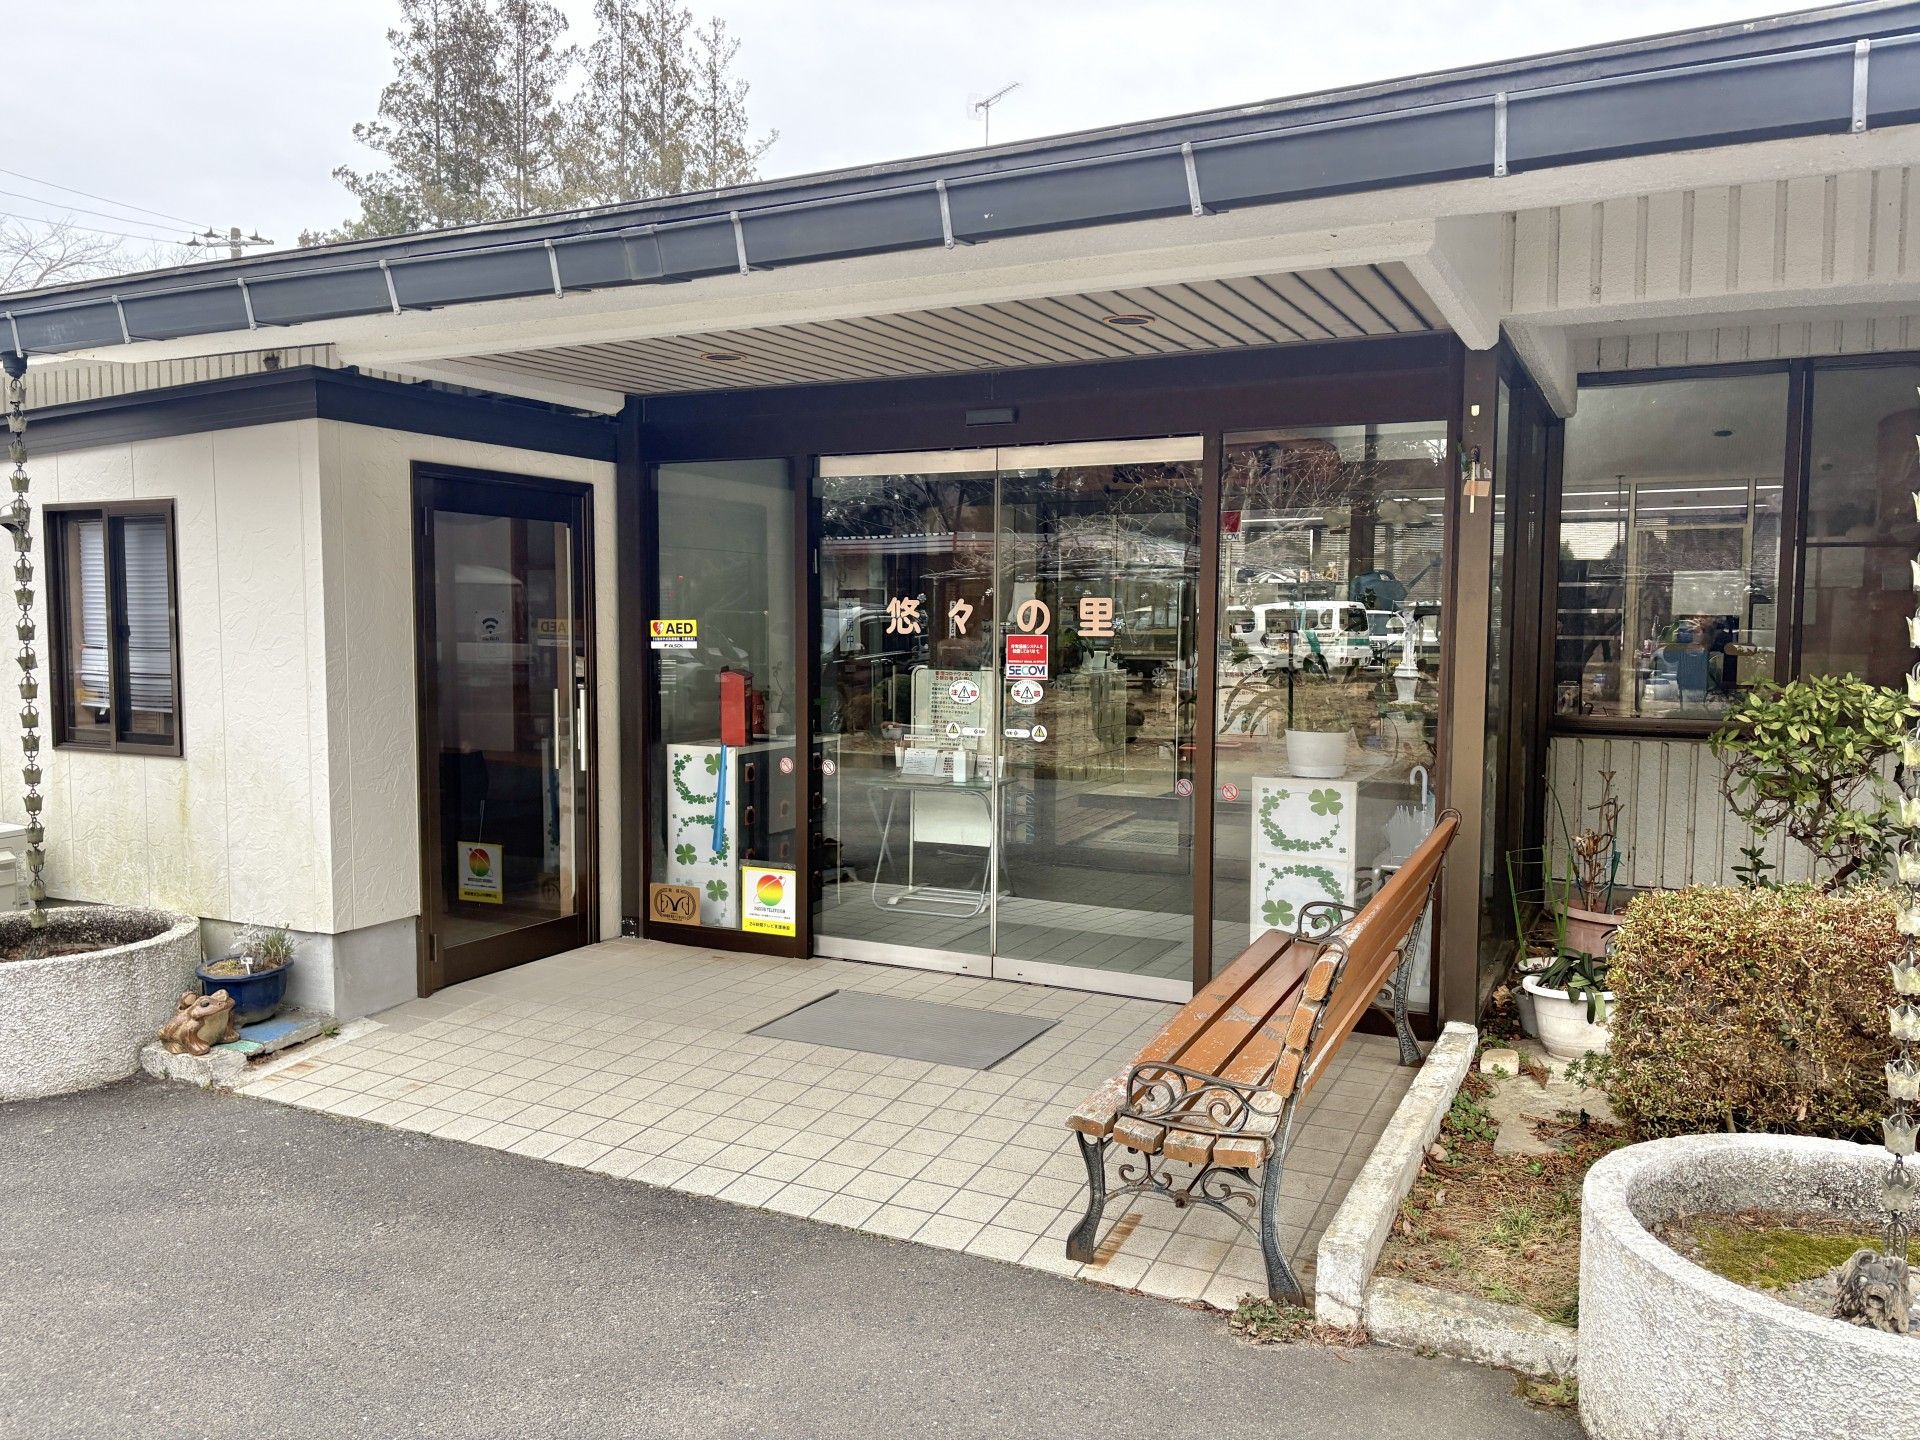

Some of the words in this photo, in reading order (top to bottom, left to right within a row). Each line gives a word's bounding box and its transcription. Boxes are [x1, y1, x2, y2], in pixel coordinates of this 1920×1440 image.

[1221, 533, 1239, 541] COM
[885, 597, 1115, 637] 悠々の里
[666, 622, 693, 634] AED
[1008, 665, 1046, 676] SECOM
